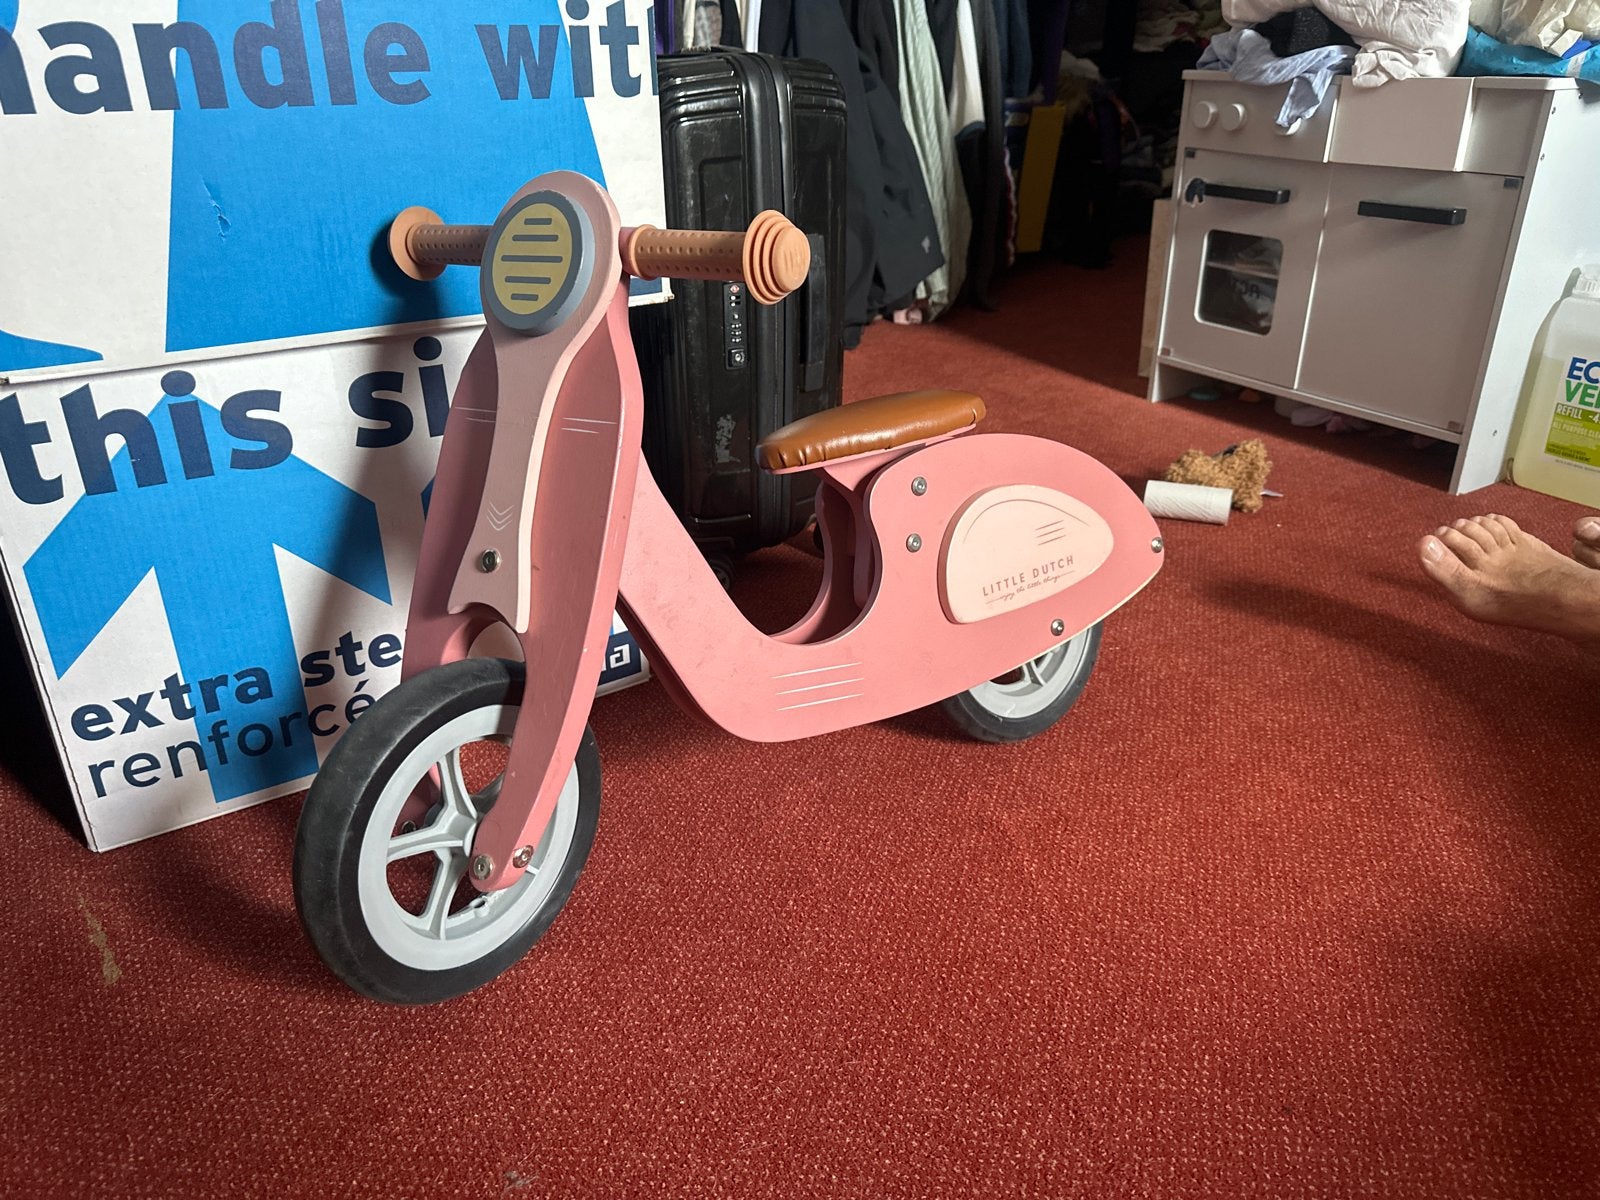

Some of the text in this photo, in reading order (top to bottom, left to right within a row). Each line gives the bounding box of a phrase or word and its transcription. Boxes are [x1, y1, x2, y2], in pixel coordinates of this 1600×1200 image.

[1556, 404, 1582, 419] REFILL
[1565, 380, 1600, 408] VE
[0, 370, 294, 505] this
[982, 555, 1074, 597] LITTLE DUTCH
[71, 667, 274, 741] extra
